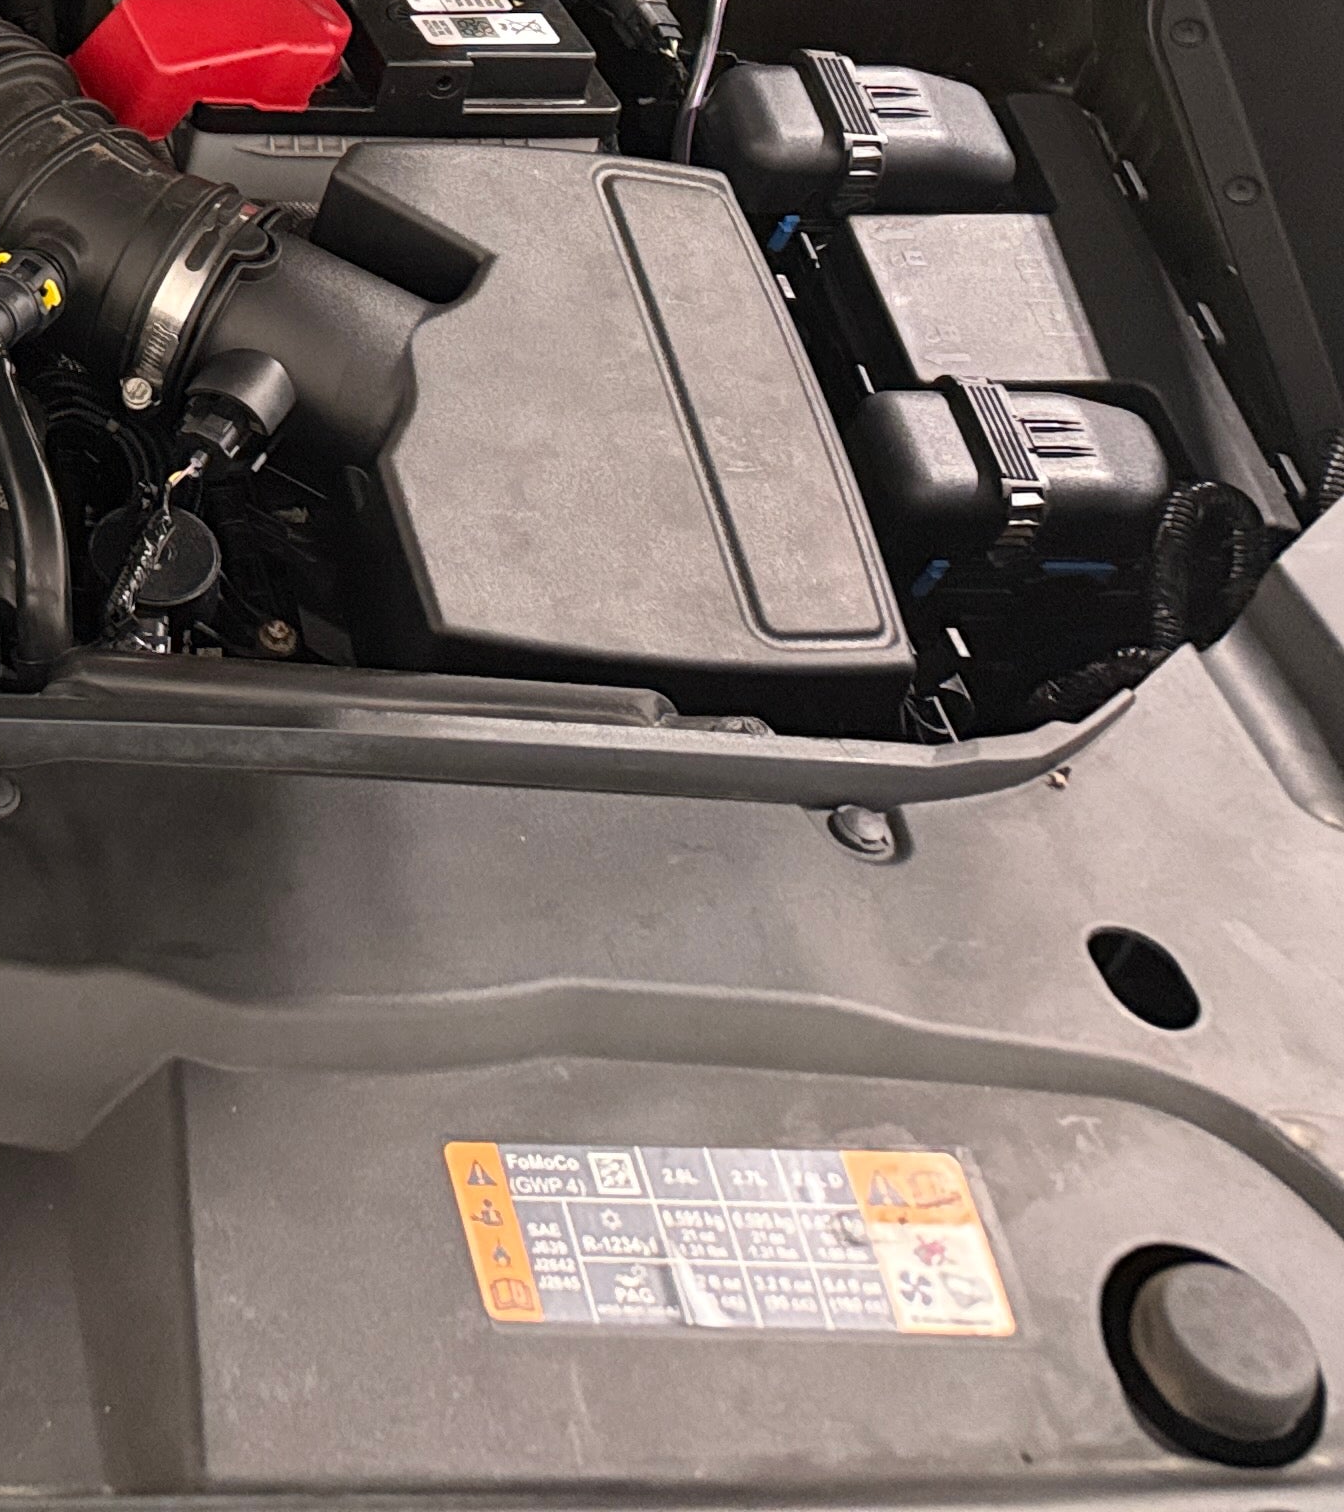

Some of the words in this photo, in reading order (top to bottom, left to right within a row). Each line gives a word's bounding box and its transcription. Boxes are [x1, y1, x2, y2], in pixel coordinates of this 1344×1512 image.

[505, 1153, 581, 1171] FoMoCo
[509, 1176, 564, 1195] (GWP
[565, 1177, 587, 1197] 4)
[526, 1221, 563, 1239] SAE
[614, 1287, 656, 1305] PAG
